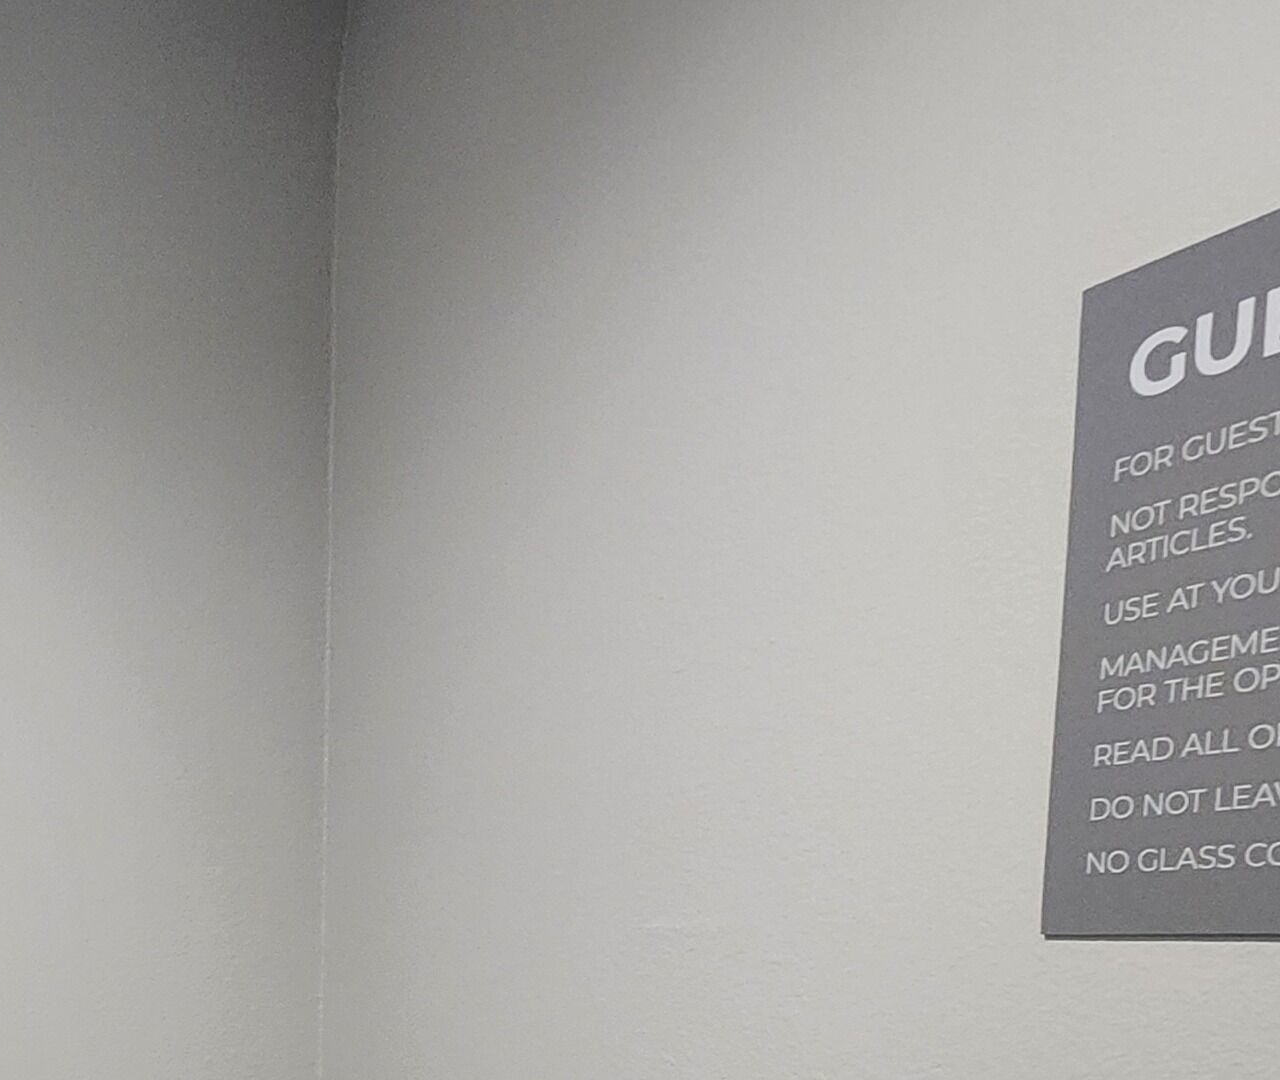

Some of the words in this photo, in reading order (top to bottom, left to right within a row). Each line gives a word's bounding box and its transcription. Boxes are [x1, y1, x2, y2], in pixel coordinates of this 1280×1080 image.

[1113, 444, 1174, 482] FOR
[1110, 500, 1172, 538] NOT
[1105, 516, 1253, 573] ARTICLES.
[1104, 592, 1161, 625] USE
[1167, 582, 1206, 614] AT
[1211, 566, 1280, 604] YOU
[1099, 626, 1280, 680] MANAGEME
[1097, 683, 1157, 714] FOR
[1164, 671, 1224, 704] THE
[1093, 736, 1175, 767] READ
[1180, 728, 1241, 757] ALL
[1248, 722, 1280, 749] O
[1090, 795, 1135, 822] DO
[1142, 788, 1208, 817] NOT
[1086, 850, 1130, 875] NO
[1137, 844, 1236, 872] GLASS
